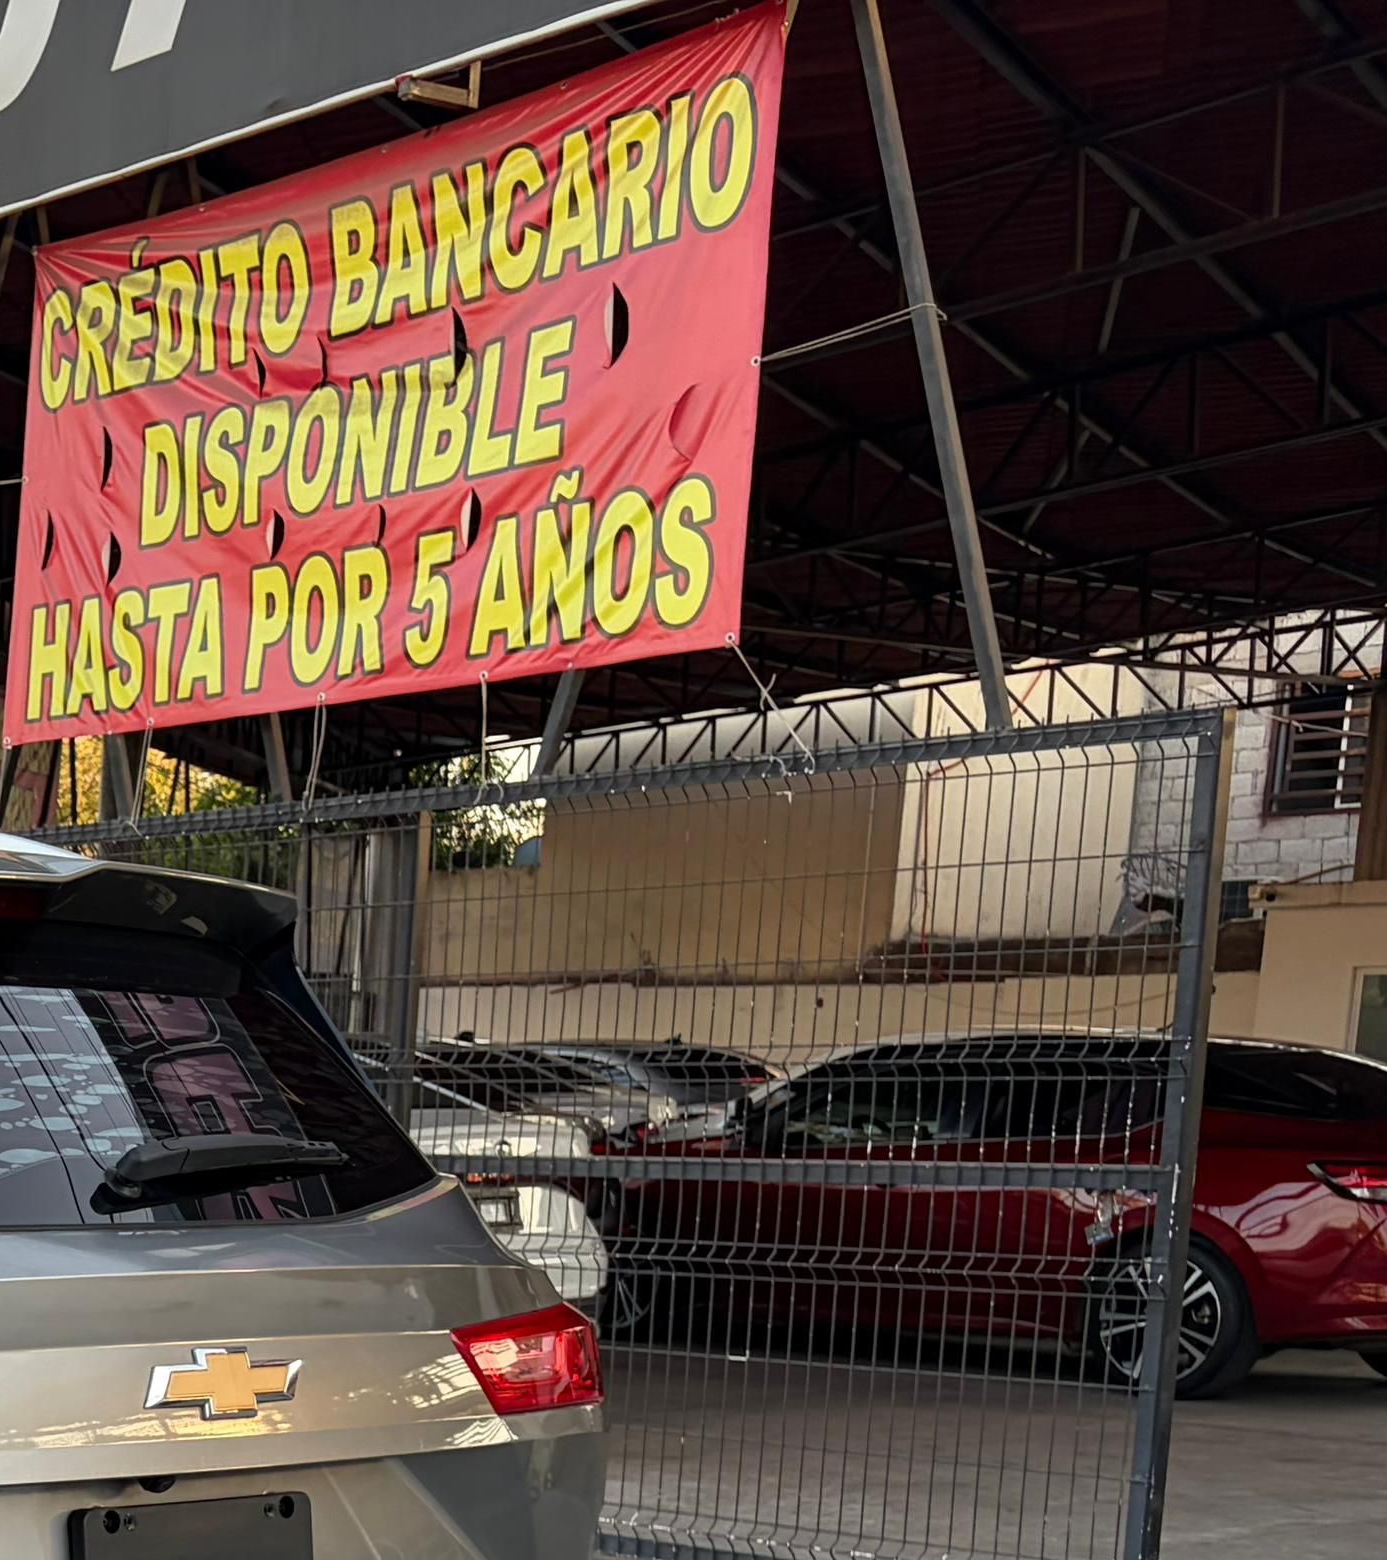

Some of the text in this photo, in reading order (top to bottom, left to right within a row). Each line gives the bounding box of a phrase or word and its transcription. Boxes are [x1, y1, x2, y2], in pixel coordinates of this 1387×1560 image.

[39, 72, 756, 411] CRÉDITO BANCARIO
[138, 317, 577, 548] DISPONIBLE
[26, 468, 716, 722] HASTA POR 5 AÑOS
